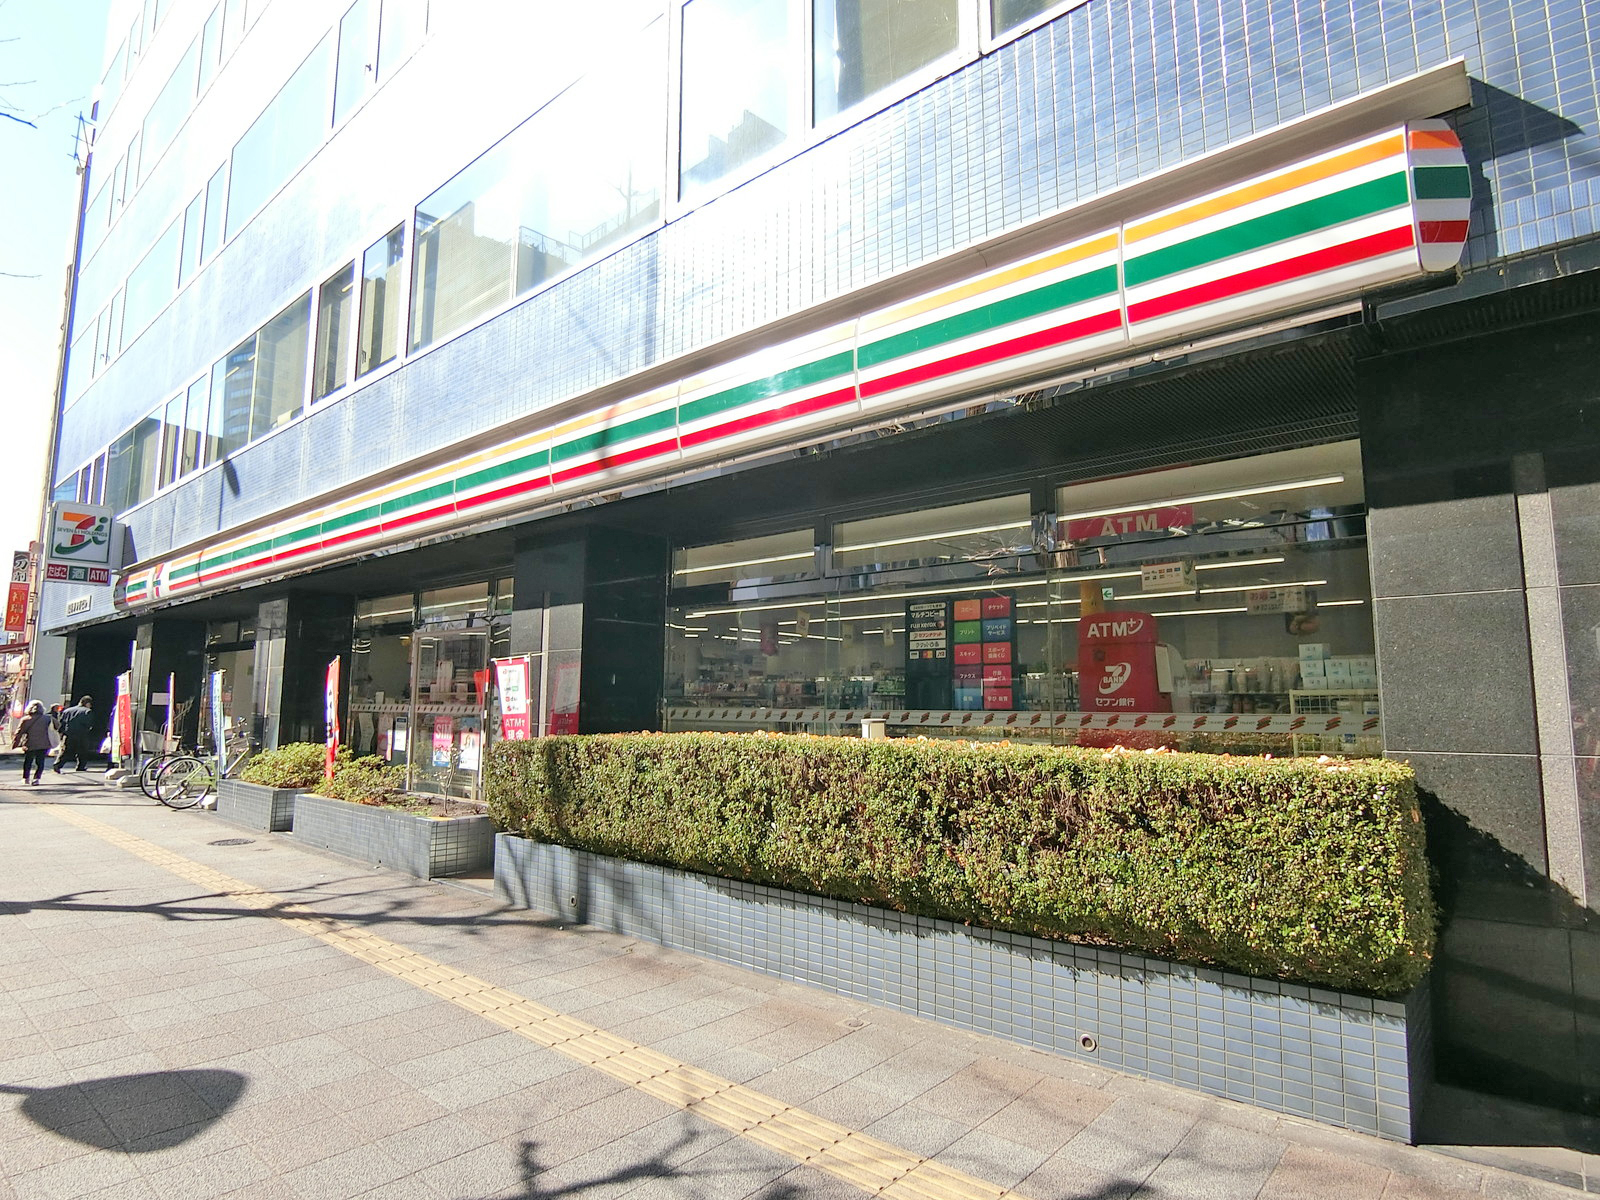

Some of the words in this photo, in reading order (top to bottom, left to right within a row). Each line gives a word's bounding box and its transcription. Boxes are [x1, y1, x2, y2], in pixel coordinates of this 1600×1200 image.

[1100, 514, 1158, 536] ATM
[80, 530, 108, 538] HOLDINGS
[48, 566, 67, 578] たばこ
[71, 568, 85, 579] 酒
[90, 568, 108, 581] ATM
[1103, 676, 1125, 684] BANK
[1095, 697, 1135, 707] セブン銀行
